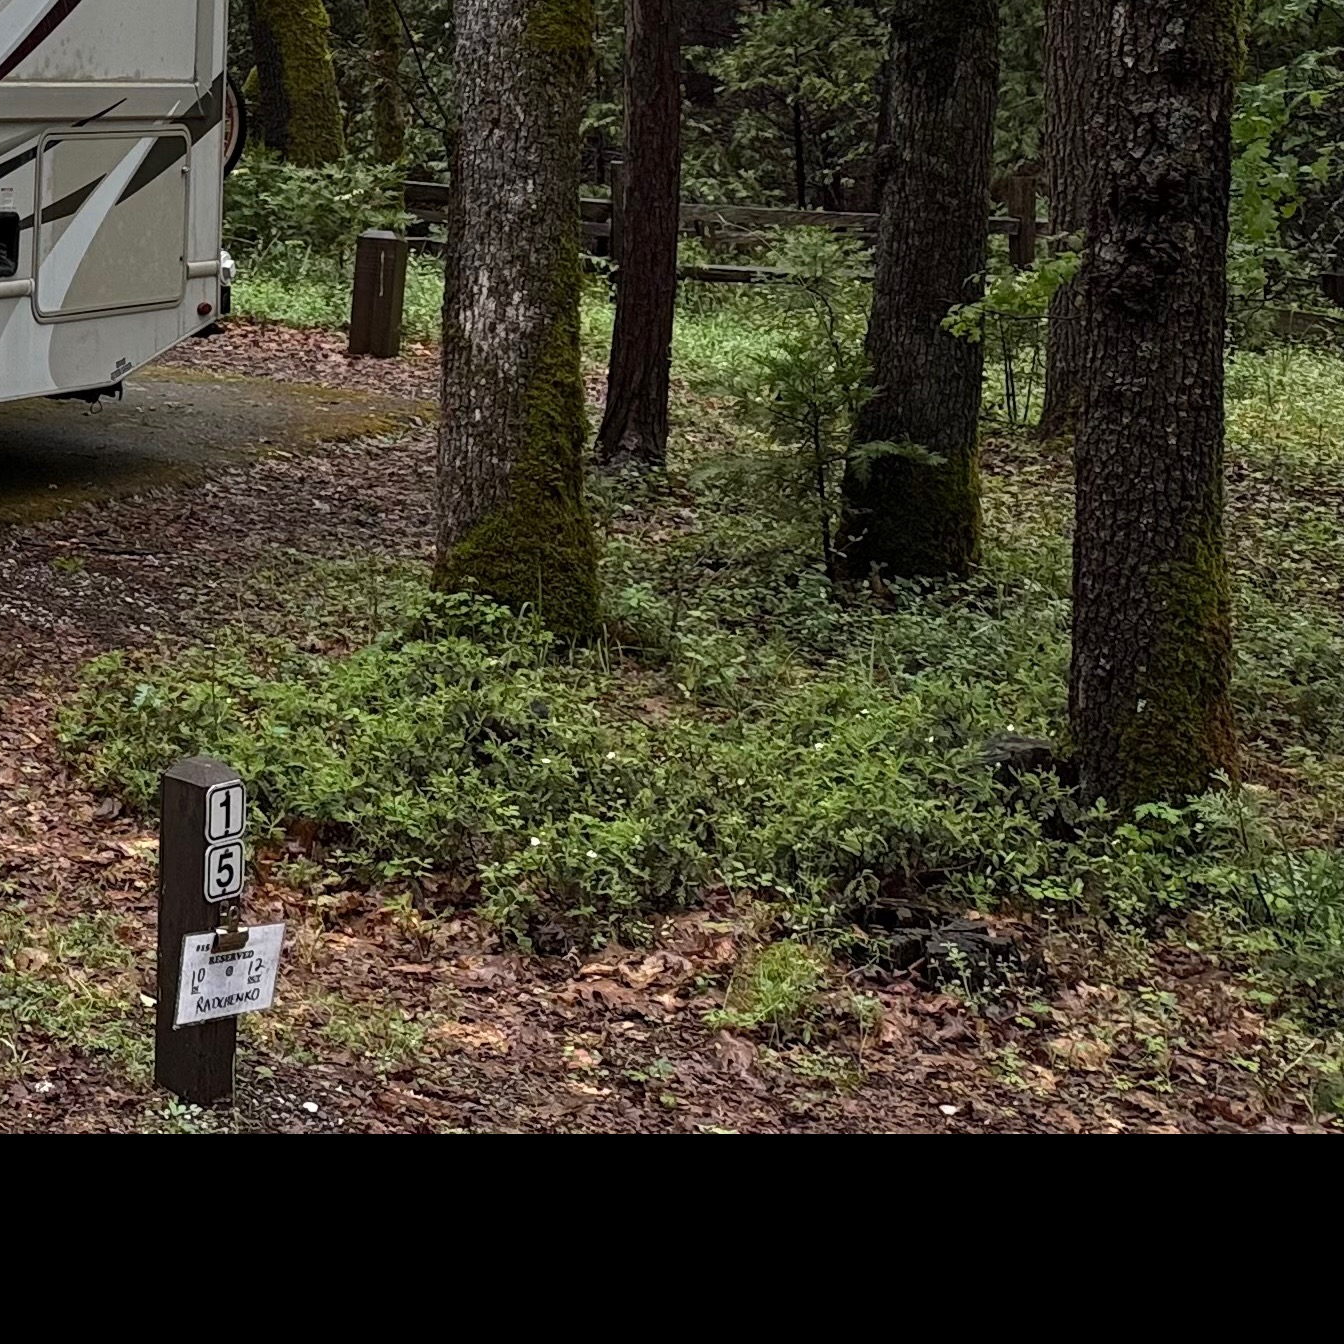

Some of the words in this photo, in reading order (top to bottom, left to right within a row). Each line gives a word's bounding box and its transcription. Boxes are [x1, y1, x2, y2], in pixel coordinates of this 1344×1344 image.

[220, 790, 231, 830] 1
[216, 852, 234, 888] 5
[209, 950, 254, 965] RESERVED
[248, 958, 265, 976] 12
